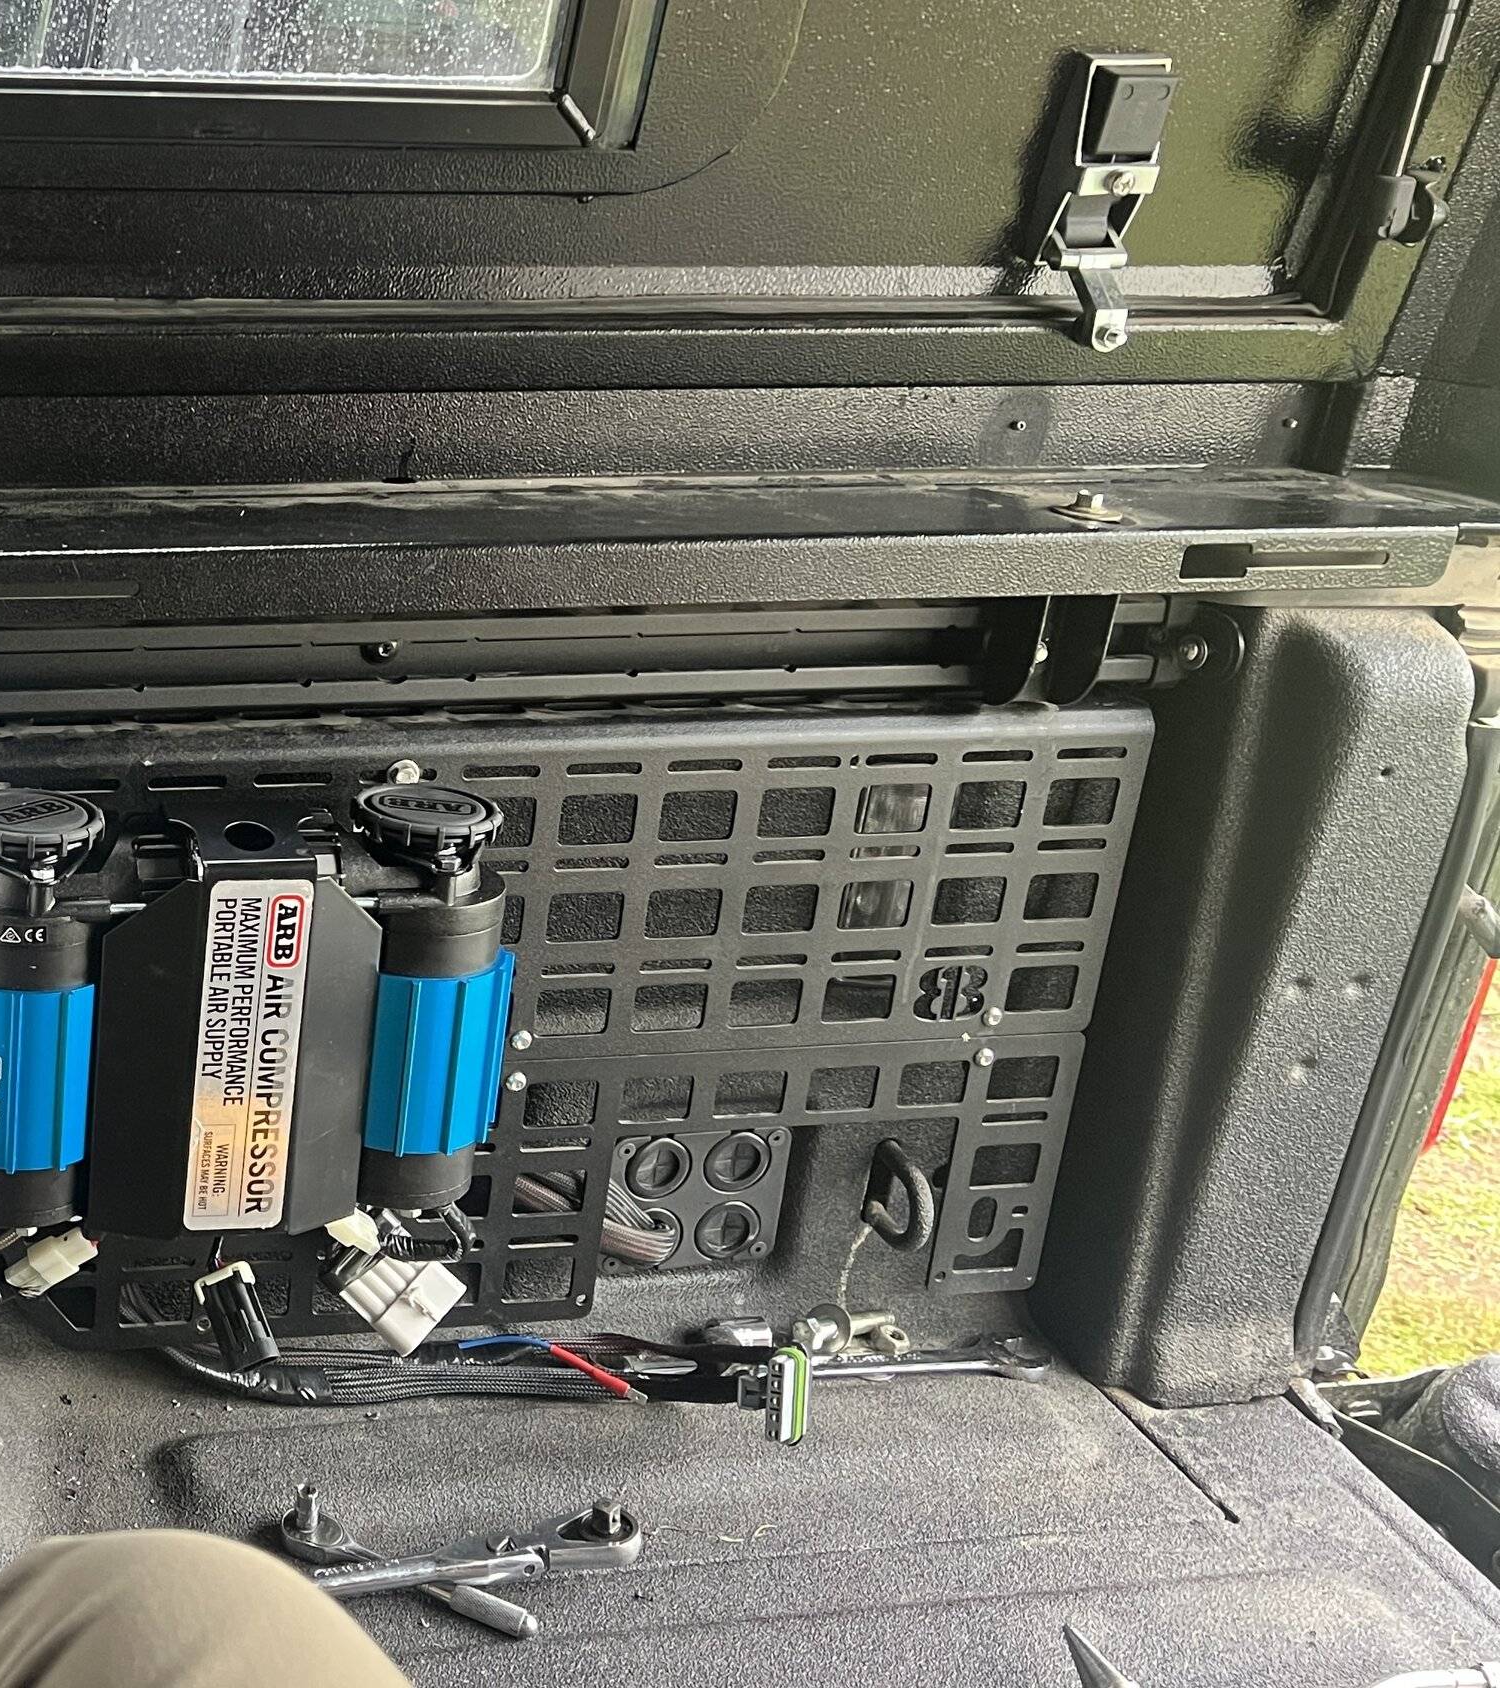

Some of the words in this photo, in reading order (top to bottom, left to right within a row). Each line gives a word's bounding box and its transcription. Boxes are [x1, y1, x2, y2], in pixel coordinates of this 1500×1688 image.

[387, 798, 466, 812] ARB
[209, 897, 238, 983] PORTABLE
[234, 897, 262, 980] MAXIMUM
[273, 903, 299, 961] ARB
[206, 986, 230, 1014] AIR
[263, 973, 295, 1020] AIR
[201, 1018, 227, 1080] SUPPLY
[223, 984, 254, 1107] PERFORMANCE
[244, 1028, 290, 1214] COMPRESSOR
[200, 1131, 213, 1168] SURFACES
[212, 1143, 230, 1198] WARNING:
[198, 1186, 209, 1195] BE
[200, 1169, 210, 1185] MAY
[197, 1196, 207, 1211] HOT
